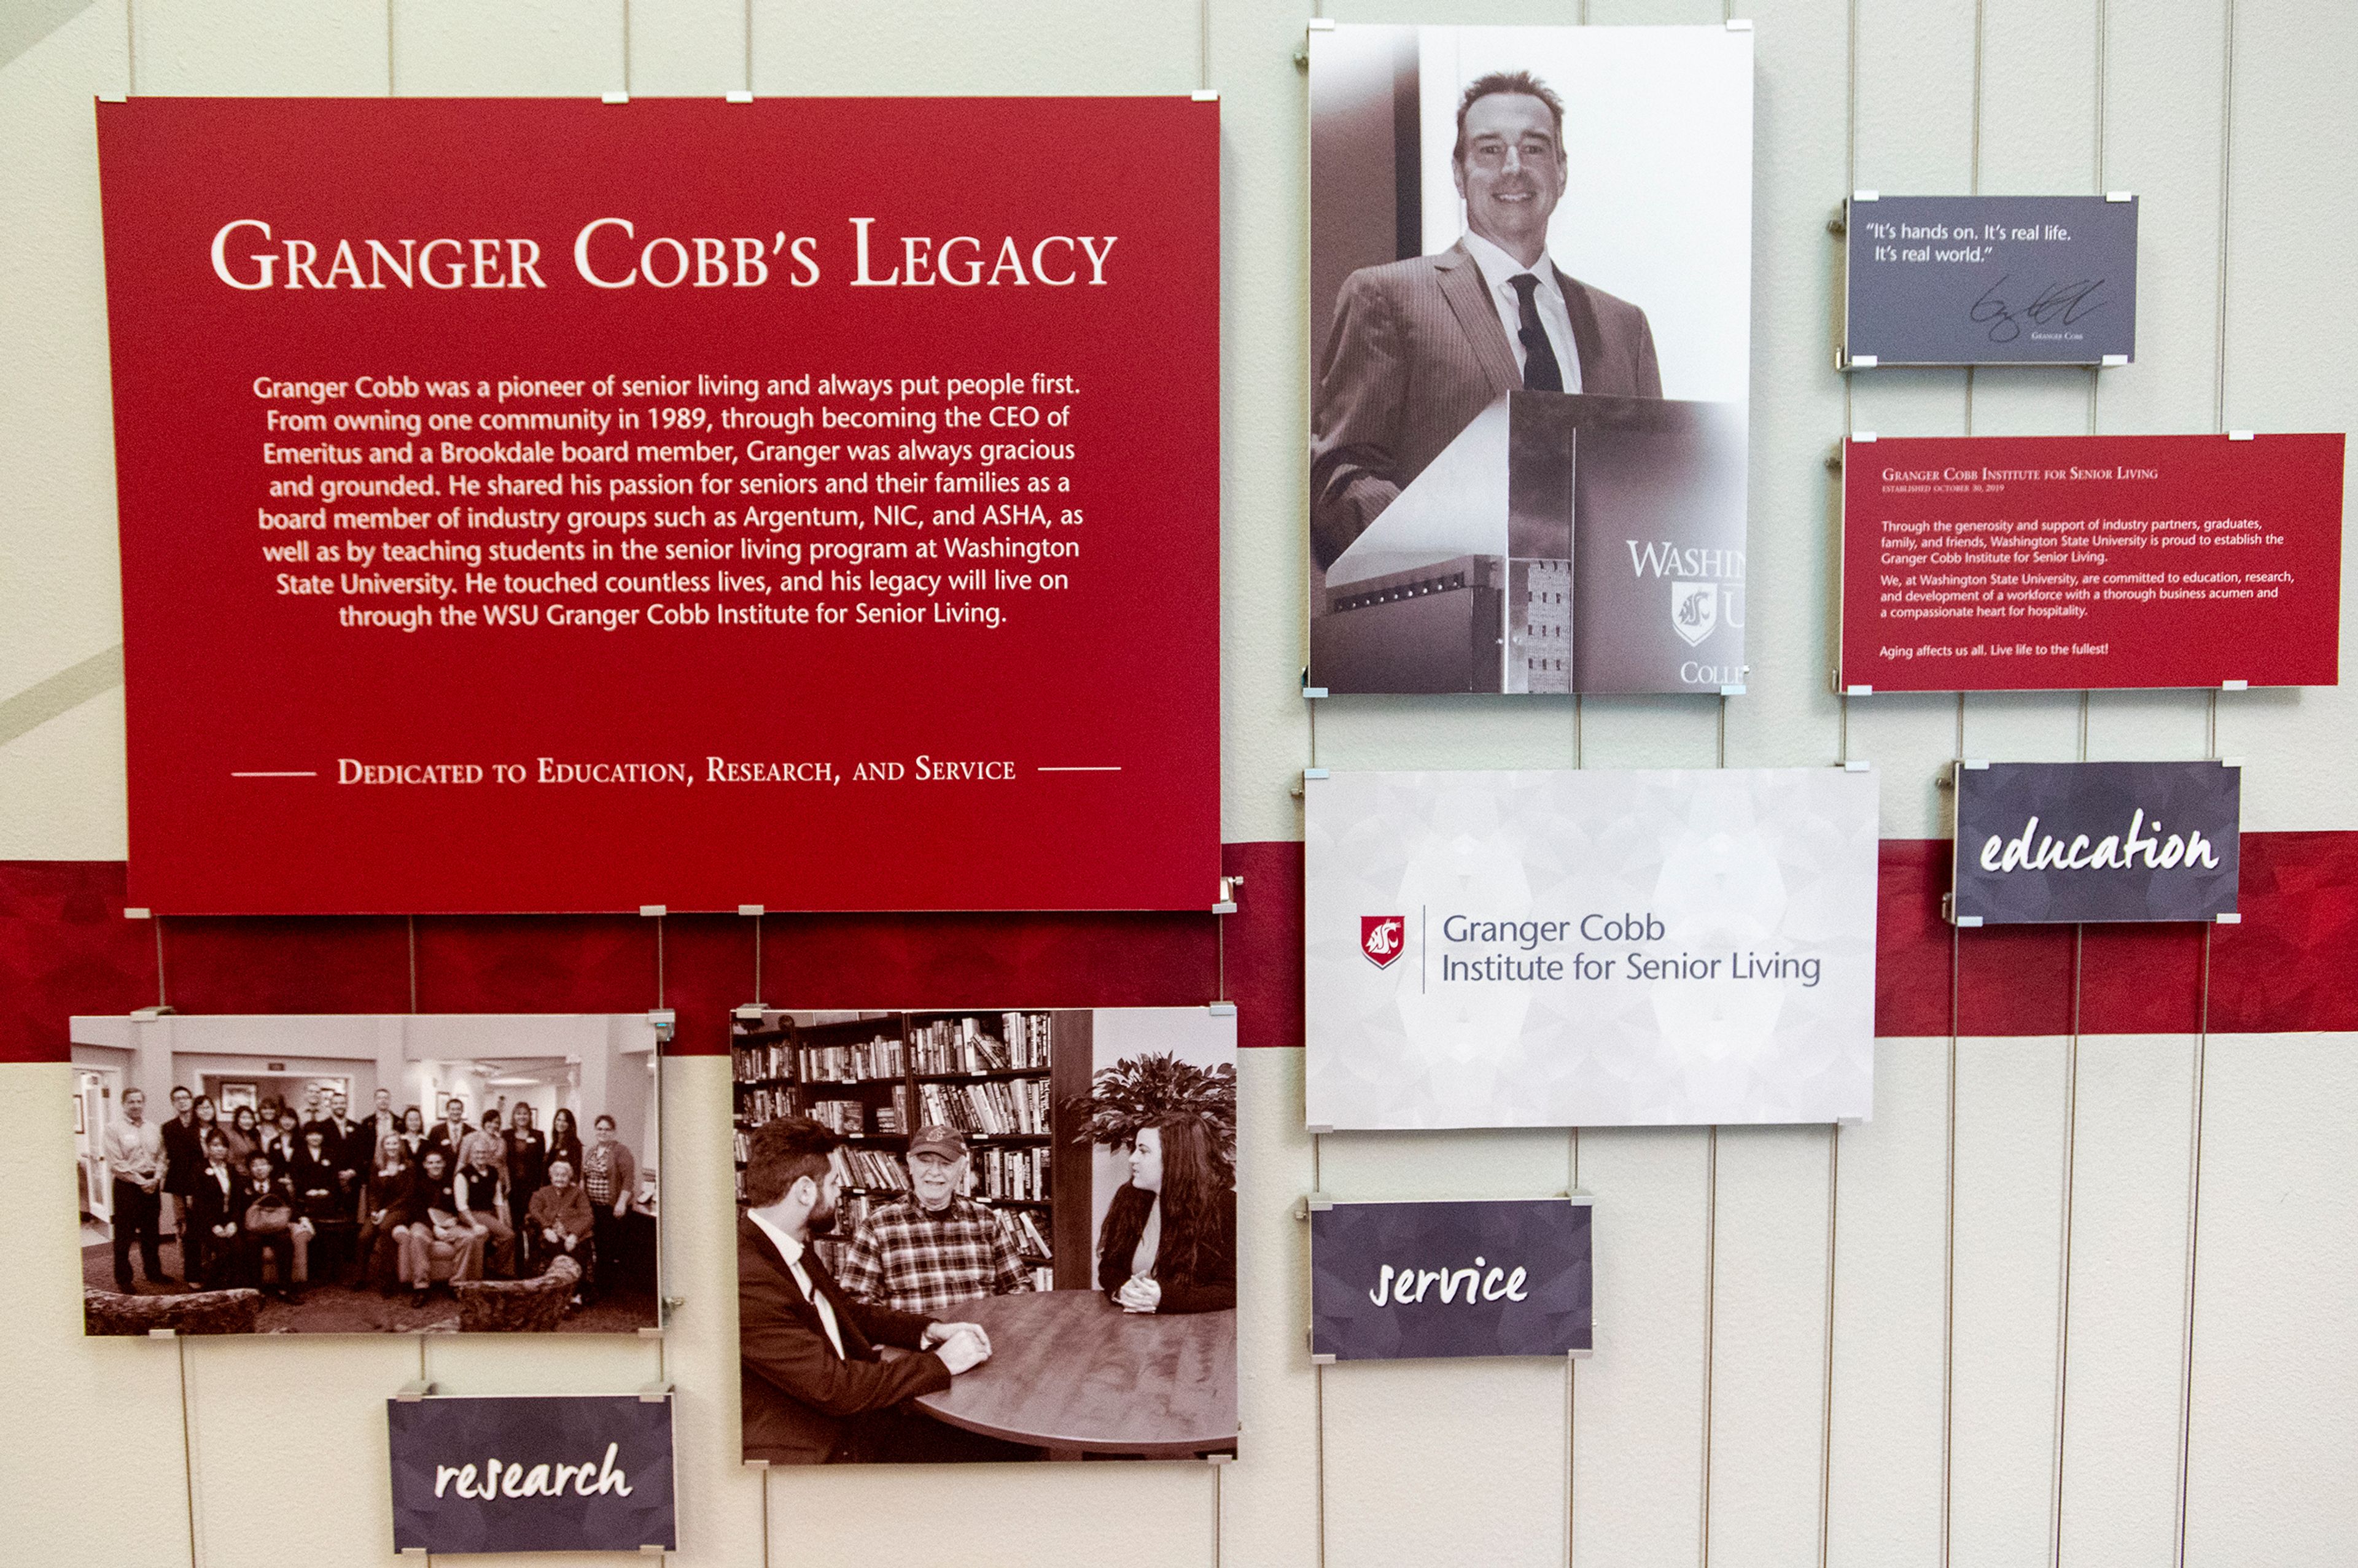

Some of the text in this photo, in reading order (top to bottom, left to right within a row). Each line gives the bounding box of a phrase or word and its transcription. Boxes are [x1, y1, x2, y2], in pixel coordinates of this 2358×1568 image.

[1866, 223, 2071, 240] "It's hands on. It's real life.
[211, 217, 1117, 290] GRANGER COBB'S LEGACY
[1875, 246, 1993, 262] It's real world."
[252, 372, 1080, 405] Granger Cobb was a pioneer of senior living and always put people first.
[267, 405, 1070, 438] From owning one community in 1989, through becoming the CEO of
[263, 438, 1075, 468] Emeritus and a Brookdale board member, Granger was always gracious
[269, 471, 1070, 503] and grounded. He shared his passion for seniors and their families as a
[1882, 466, 2158, 482] GRANGER COBB INSTITUTE FOR SENIOR LIVING
[1882, 518, 2262, 535] Through the generosity and support of industry partners, graduates,
[1881, 534, 2284, 551] family, and friends, Washington State University is proud to establish the
[1881, 551, 2108, 567] Granger Cobb Institute for Senior Living.
[276, 569, 1068, 600] State University. He touched countless lives, and his legacy will live on
[339, 602, 1006, 633] through the WSU Granger Cobb Institute for Senior Living.
[1880, 605, 2088, 620] a compassionate heart for hospitality.
[1880, 643, 2109, 659] Aging affects us all. Live life to the fullest!
[338, 754, 1016, 787] DEDICATED TO EDUCATION, RESEARCH, AND SERVICE
[1980, 808, 2219, 872] education
[1443, 912, 1665, 950] Granger Cobb
[1443, 951, 1821, 988] Institute for Senior Living
[1369, 1256, 1527, 1306] service
[434, 1442, 633, 1500] research
